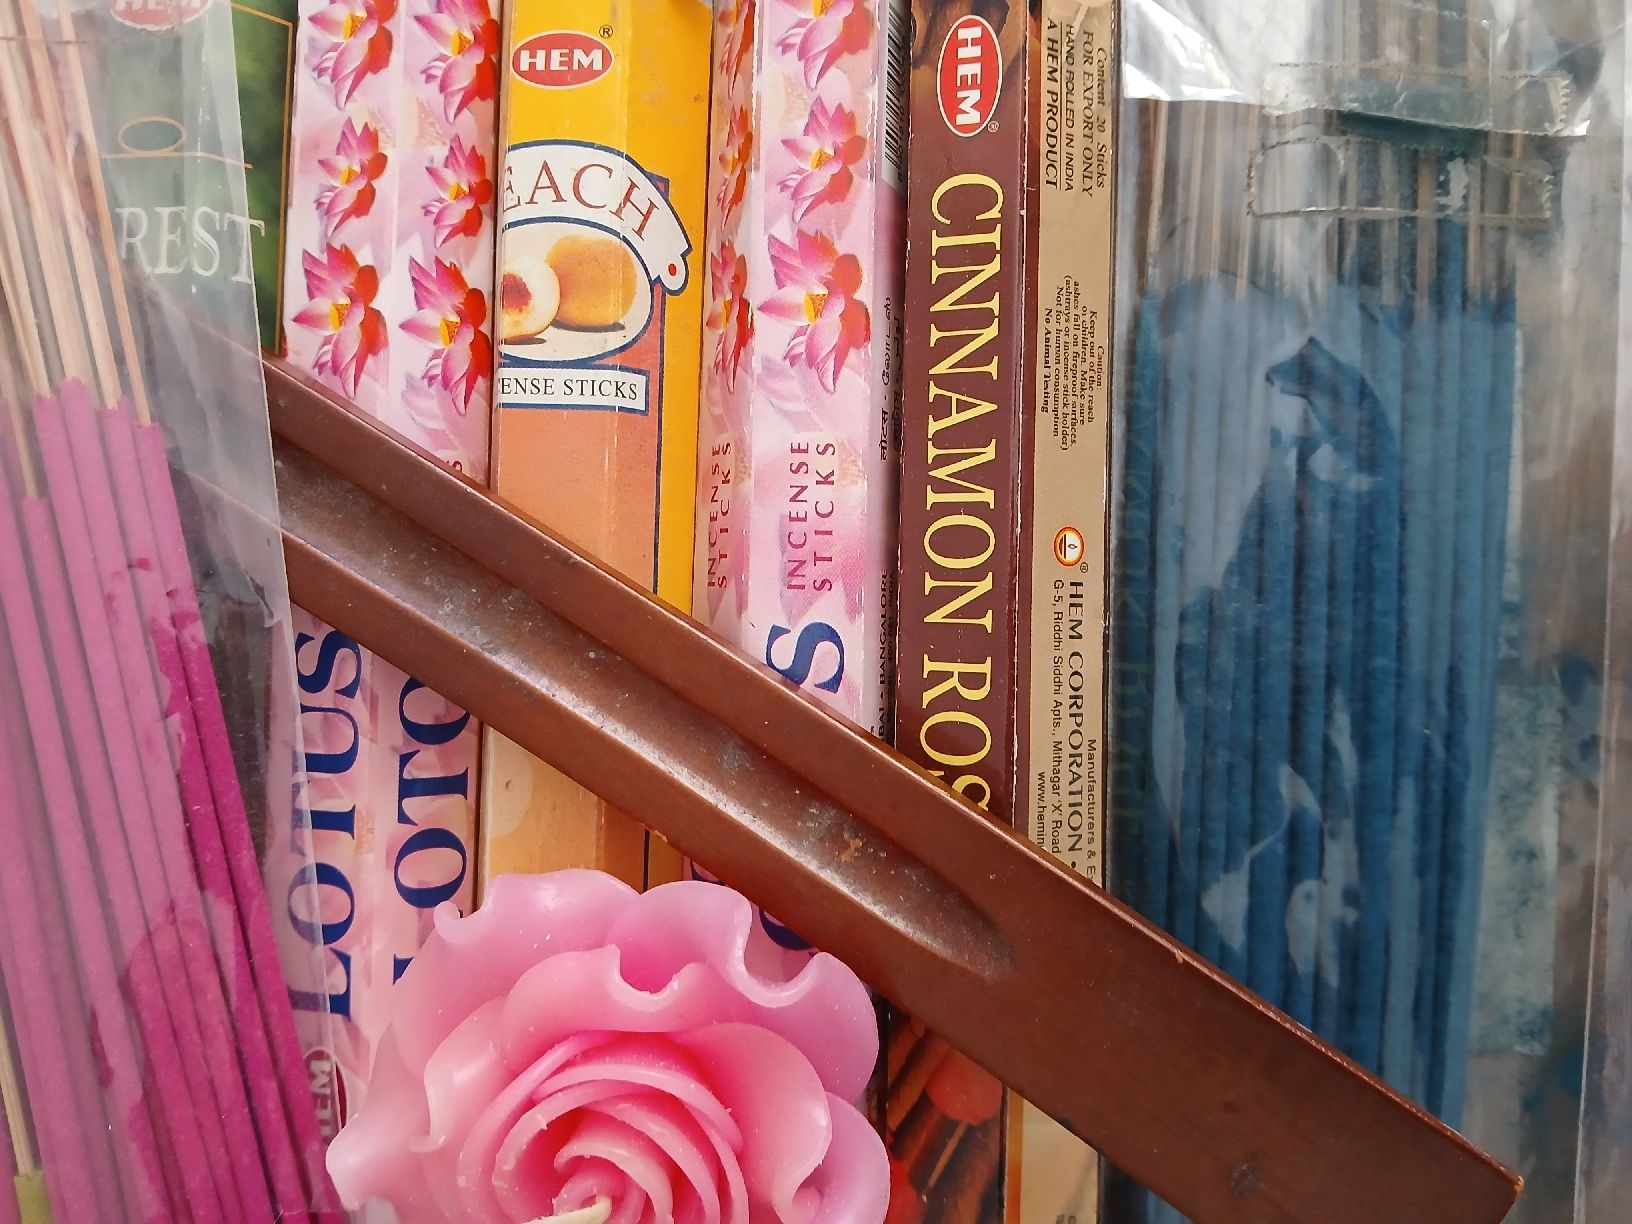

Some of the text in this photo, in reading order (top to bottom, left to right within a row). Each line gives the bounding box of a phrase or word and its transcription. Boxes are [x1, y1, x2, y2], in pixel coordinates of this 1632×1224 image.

[519, 49, 603, 72] HEM
[955, 26, 983, 126] HEM
[1044, 17, 1059, 191] A HEM PRODUCT
[1064, 24, 1075, 193] HAND ROLLED IN INDIA
[1080, 31, 1094, 198] FOR EXPORT ONLY
[1094, 47, 1107, 189] Content 20 Sticks
[115, 206, 265, 284] REST
[503, 160, 660, 242] EACH
[1040, 307, 1053, 414] No Animal Testing
[1051, 286, 1063, 437] Not for human consumption
[1059, 274, 1072, 451] (ashtrays or incense stick holder)
[1069, 281, 1080, 447] ashes fall on fireproof surfaces.
[1087, 310, 1097, 339] Keep
[1087, 361, 1096, 374] of
[1095, 345, 1105, 391] Caution:
[501, 378, 637, 400] ENSE STICKS
[923, 173, 1004, 634] CINNAMON
[1078, 369, 1087, 400] Make
[1086, 394, 1095, 423] reach
[1087, 375, 1096, 392] the
[707, 444, 721, 588] INCENSE
[717, 442, 732, 588] STICKS
[787, 442, 809, 590] INCENSE
[813, 442, 836, 592] STICKS
[878, 567, 888, 684] BANGALORE
[1051, 579, 1064, 607] G-5,
[1052, 611, 1064, 651] Riddhi
[1050, 699, 1062, 736] Apts.,
[1052, 655, 1063, 695] Siddhi
[1067, 581, 1084, 852] HEM CORPORATION
[920, 655, 993, 812] ROS
[1049, 740, 1063, 797] Mithagar
[286, 630, 362, 1022] LOTUS
[393, 676, 470, 986] OTO
[1050, 820, 1062, 854] Road
[1085, 739, 1097, 845] Manufacturers
[1085, 849, 1096, 860] &
